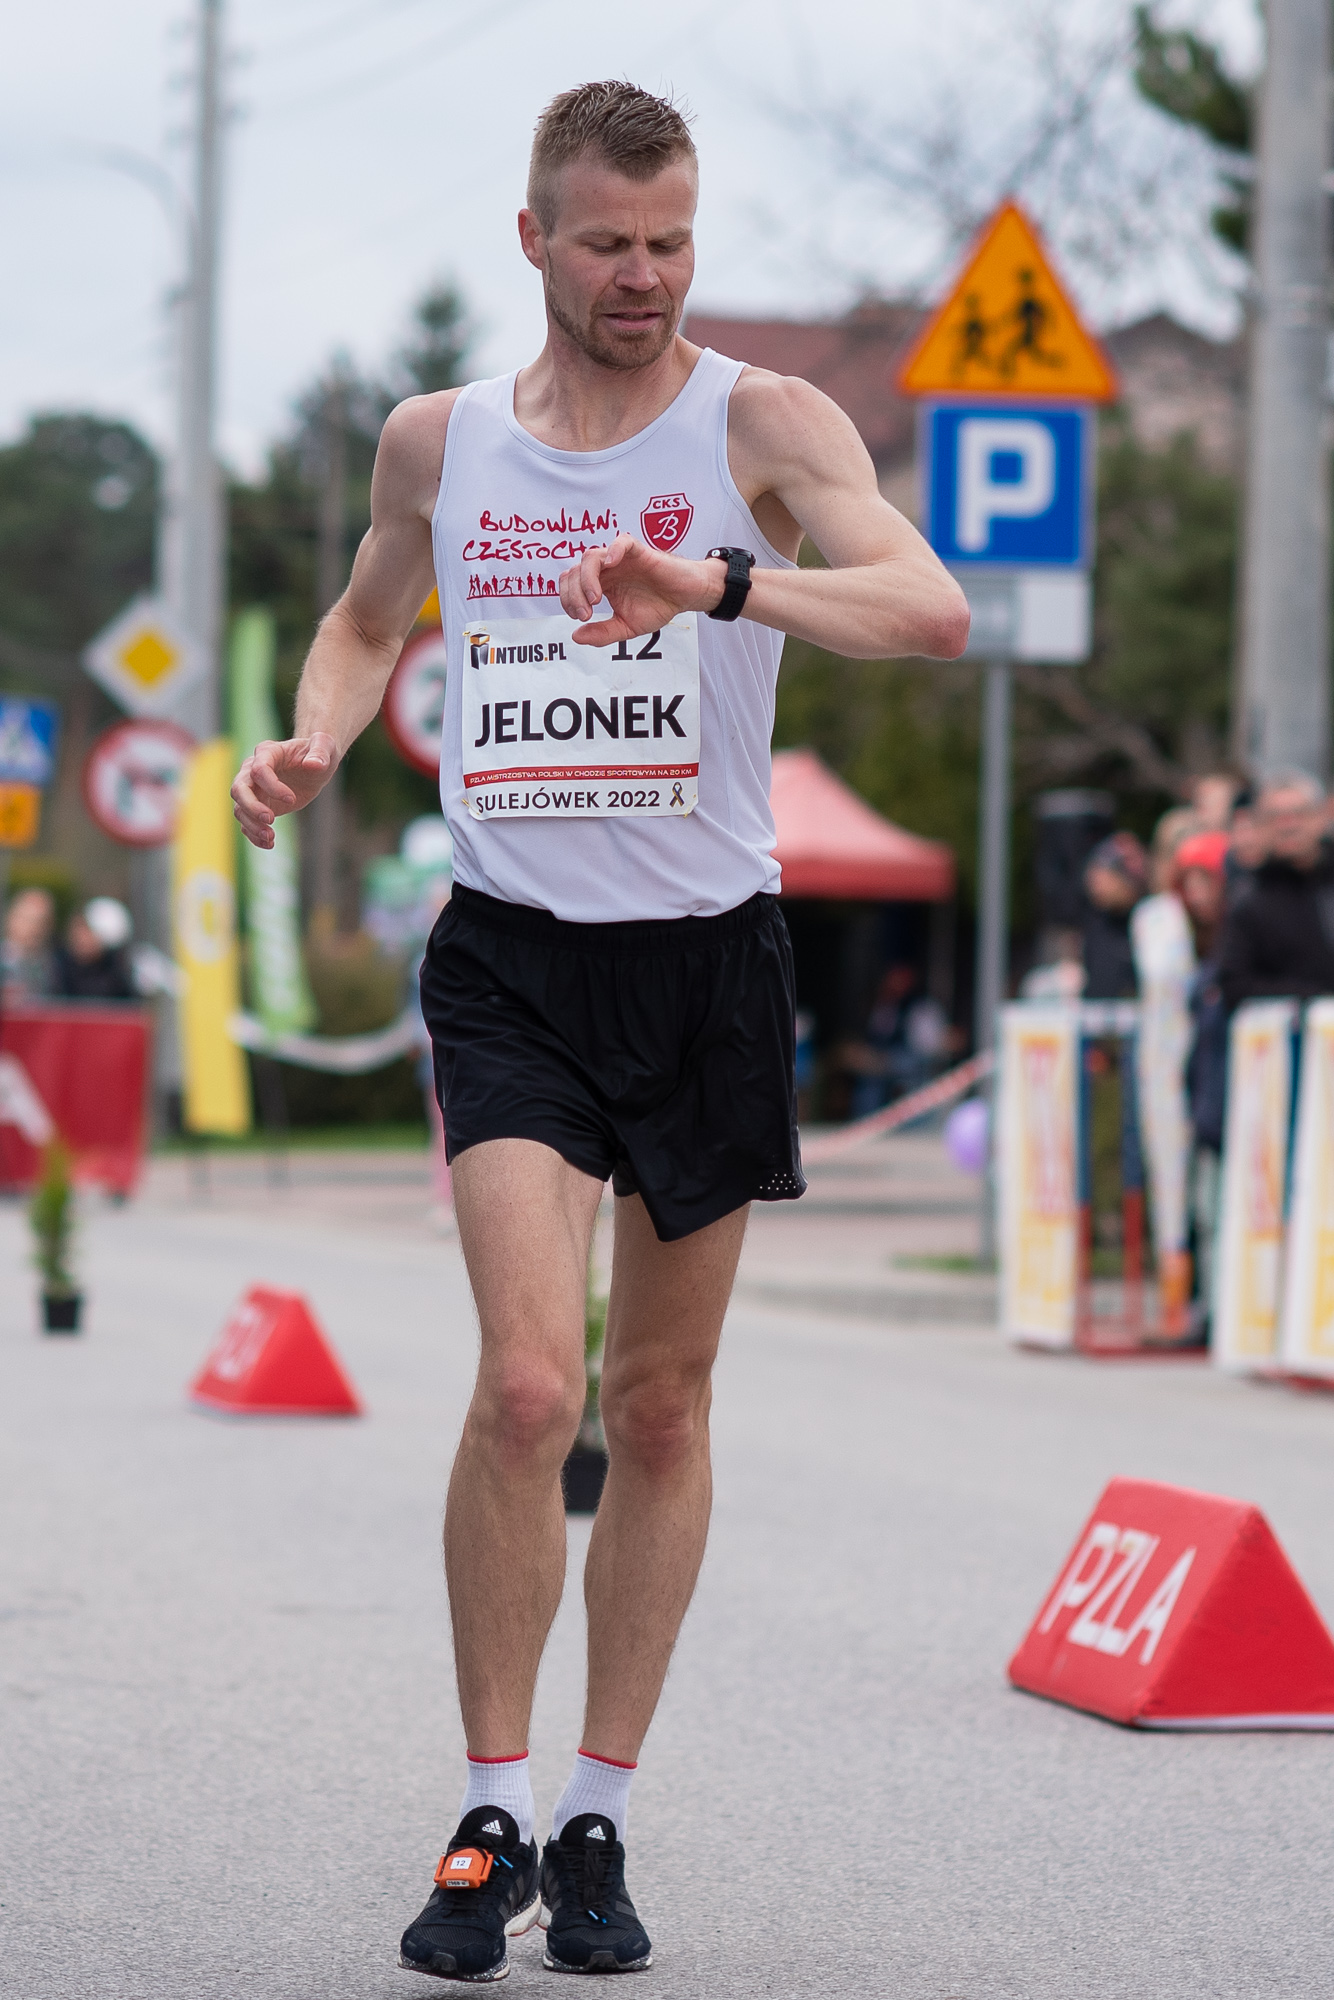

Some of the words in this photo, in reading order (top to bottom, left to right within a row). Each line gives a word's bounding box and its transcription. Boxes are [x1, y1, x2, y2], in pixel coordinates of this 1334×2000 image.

[956, 416, 1058, 555] P
[652, 497, 681, 509] CKS
[652, 512, 679, 541] B
[462, 530, 630, 562] CZĘSTOCH
[489, 642, 567, 665] INTUIS.PL
[611, 629, 663, 661] 12
[474, 694, 687, 747] JELONEK
[469, 775, 486, 785] PZLA
[487, 771, 537, 781] MISTRZOSTWA
[606, 769, 656, 777] SPORTOWYM
[476, 787, 600, 814] SULEJÓWEK
[607, 790, 660, 808] 2022
[1038, 1522, 1197, 1666] PZLA
